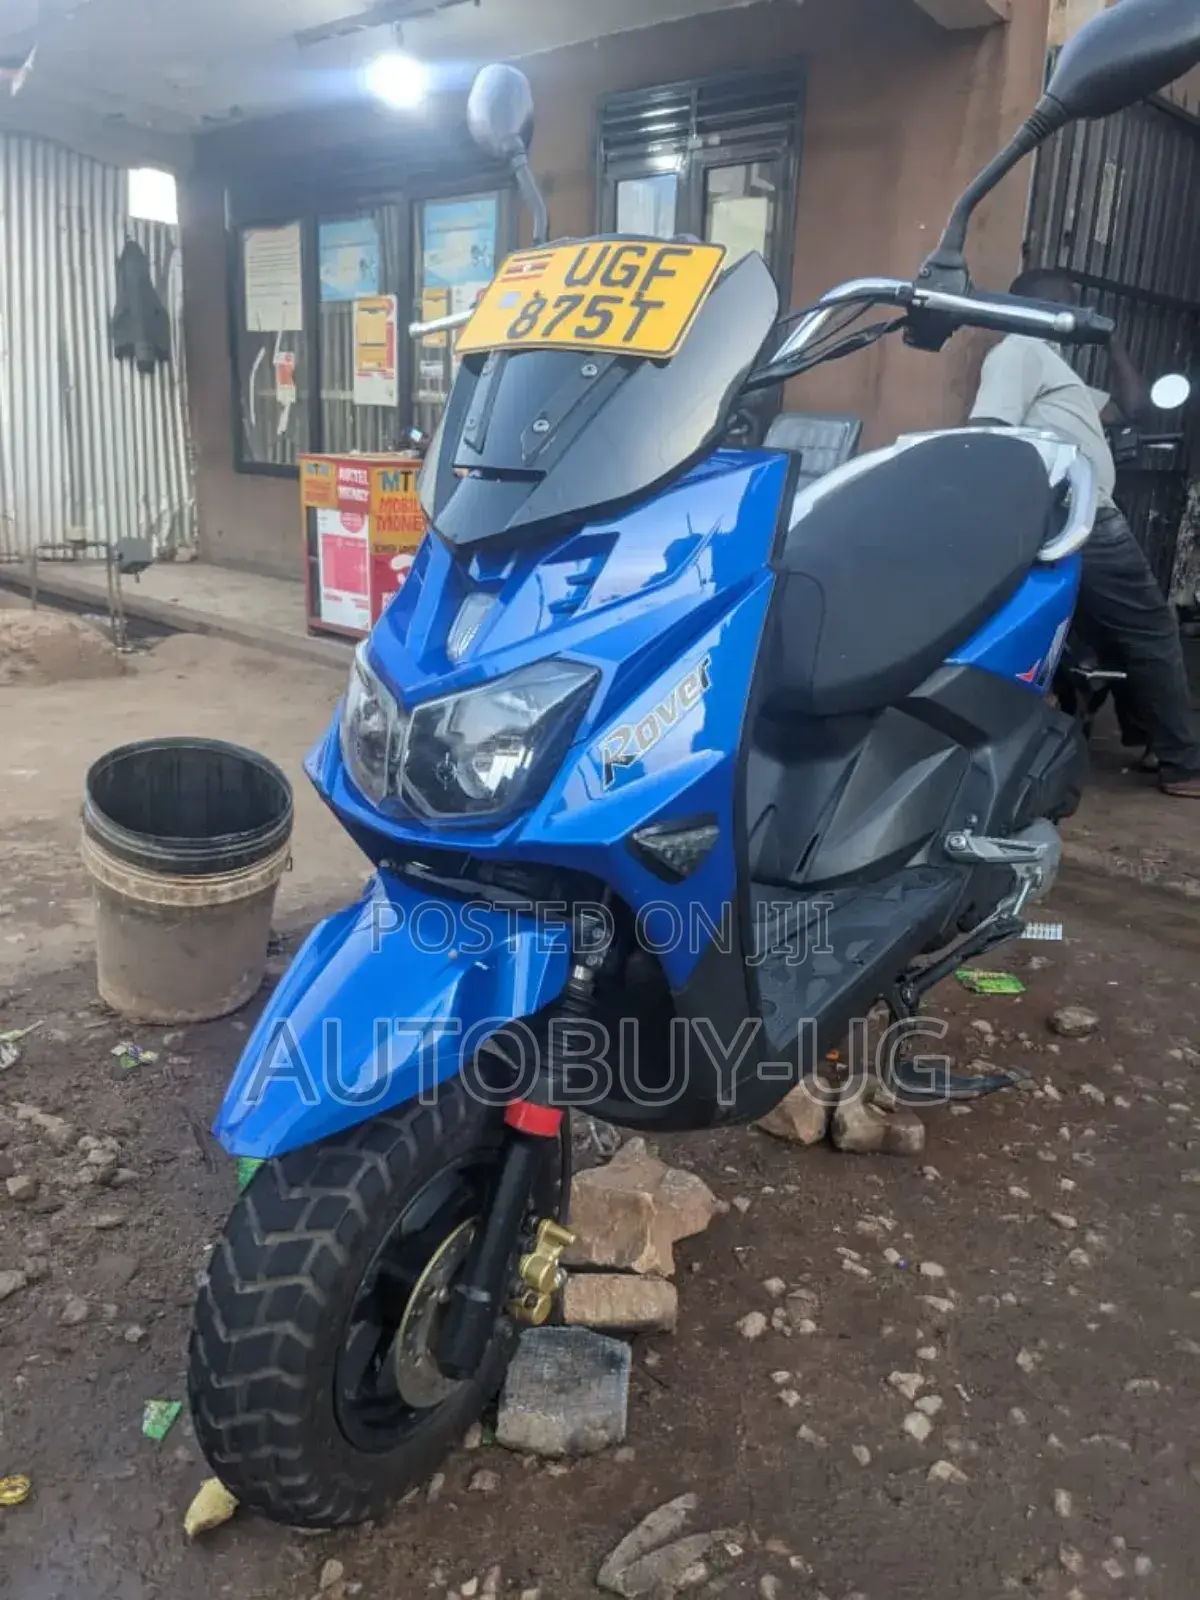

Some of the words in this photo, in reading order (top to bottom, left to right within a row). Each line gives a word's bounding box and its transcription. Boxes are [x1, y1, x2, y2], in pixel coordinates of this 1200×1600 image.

[564, 245, 693, 291] UGF
[506, 294, 665, 342] 875T
[599, 653, 712, 792] Rover
